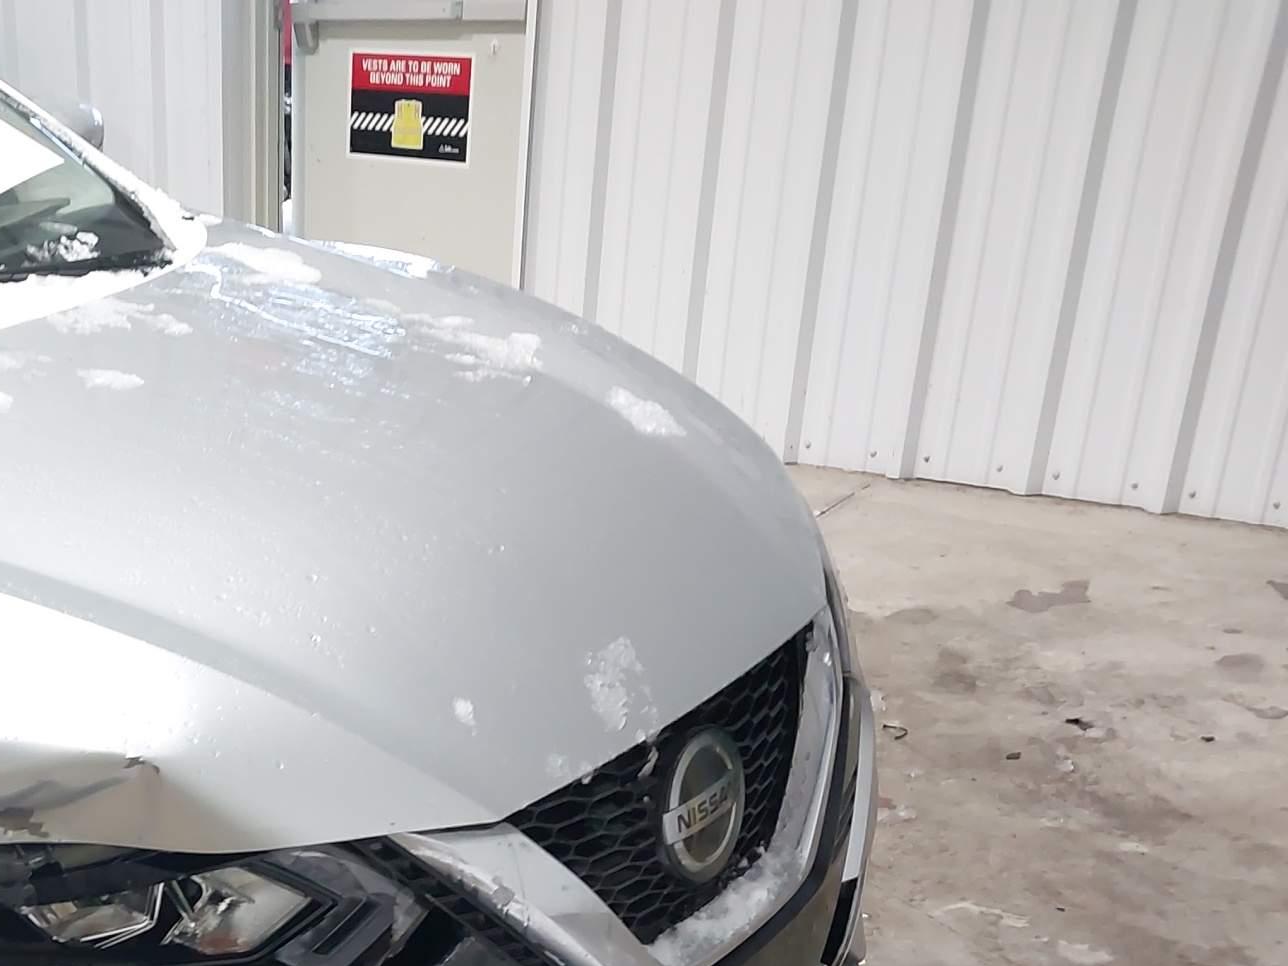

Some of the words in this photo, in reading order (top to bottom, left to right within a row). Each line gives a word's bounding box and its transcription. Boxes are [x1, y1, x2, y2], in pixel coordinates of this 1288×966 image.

[362, 58, 388, 72] VESTS
[389, 60, 406, 73] ARE
[408, 61, 419, 73] TO
[420, 61, 432, 74] BE
[433, 62, 461, 76] WORN
[369, 71, 404, 85] BEYOND
[405, 73, 424, 87] THIS
[425, 75, 452, 88] POINT
